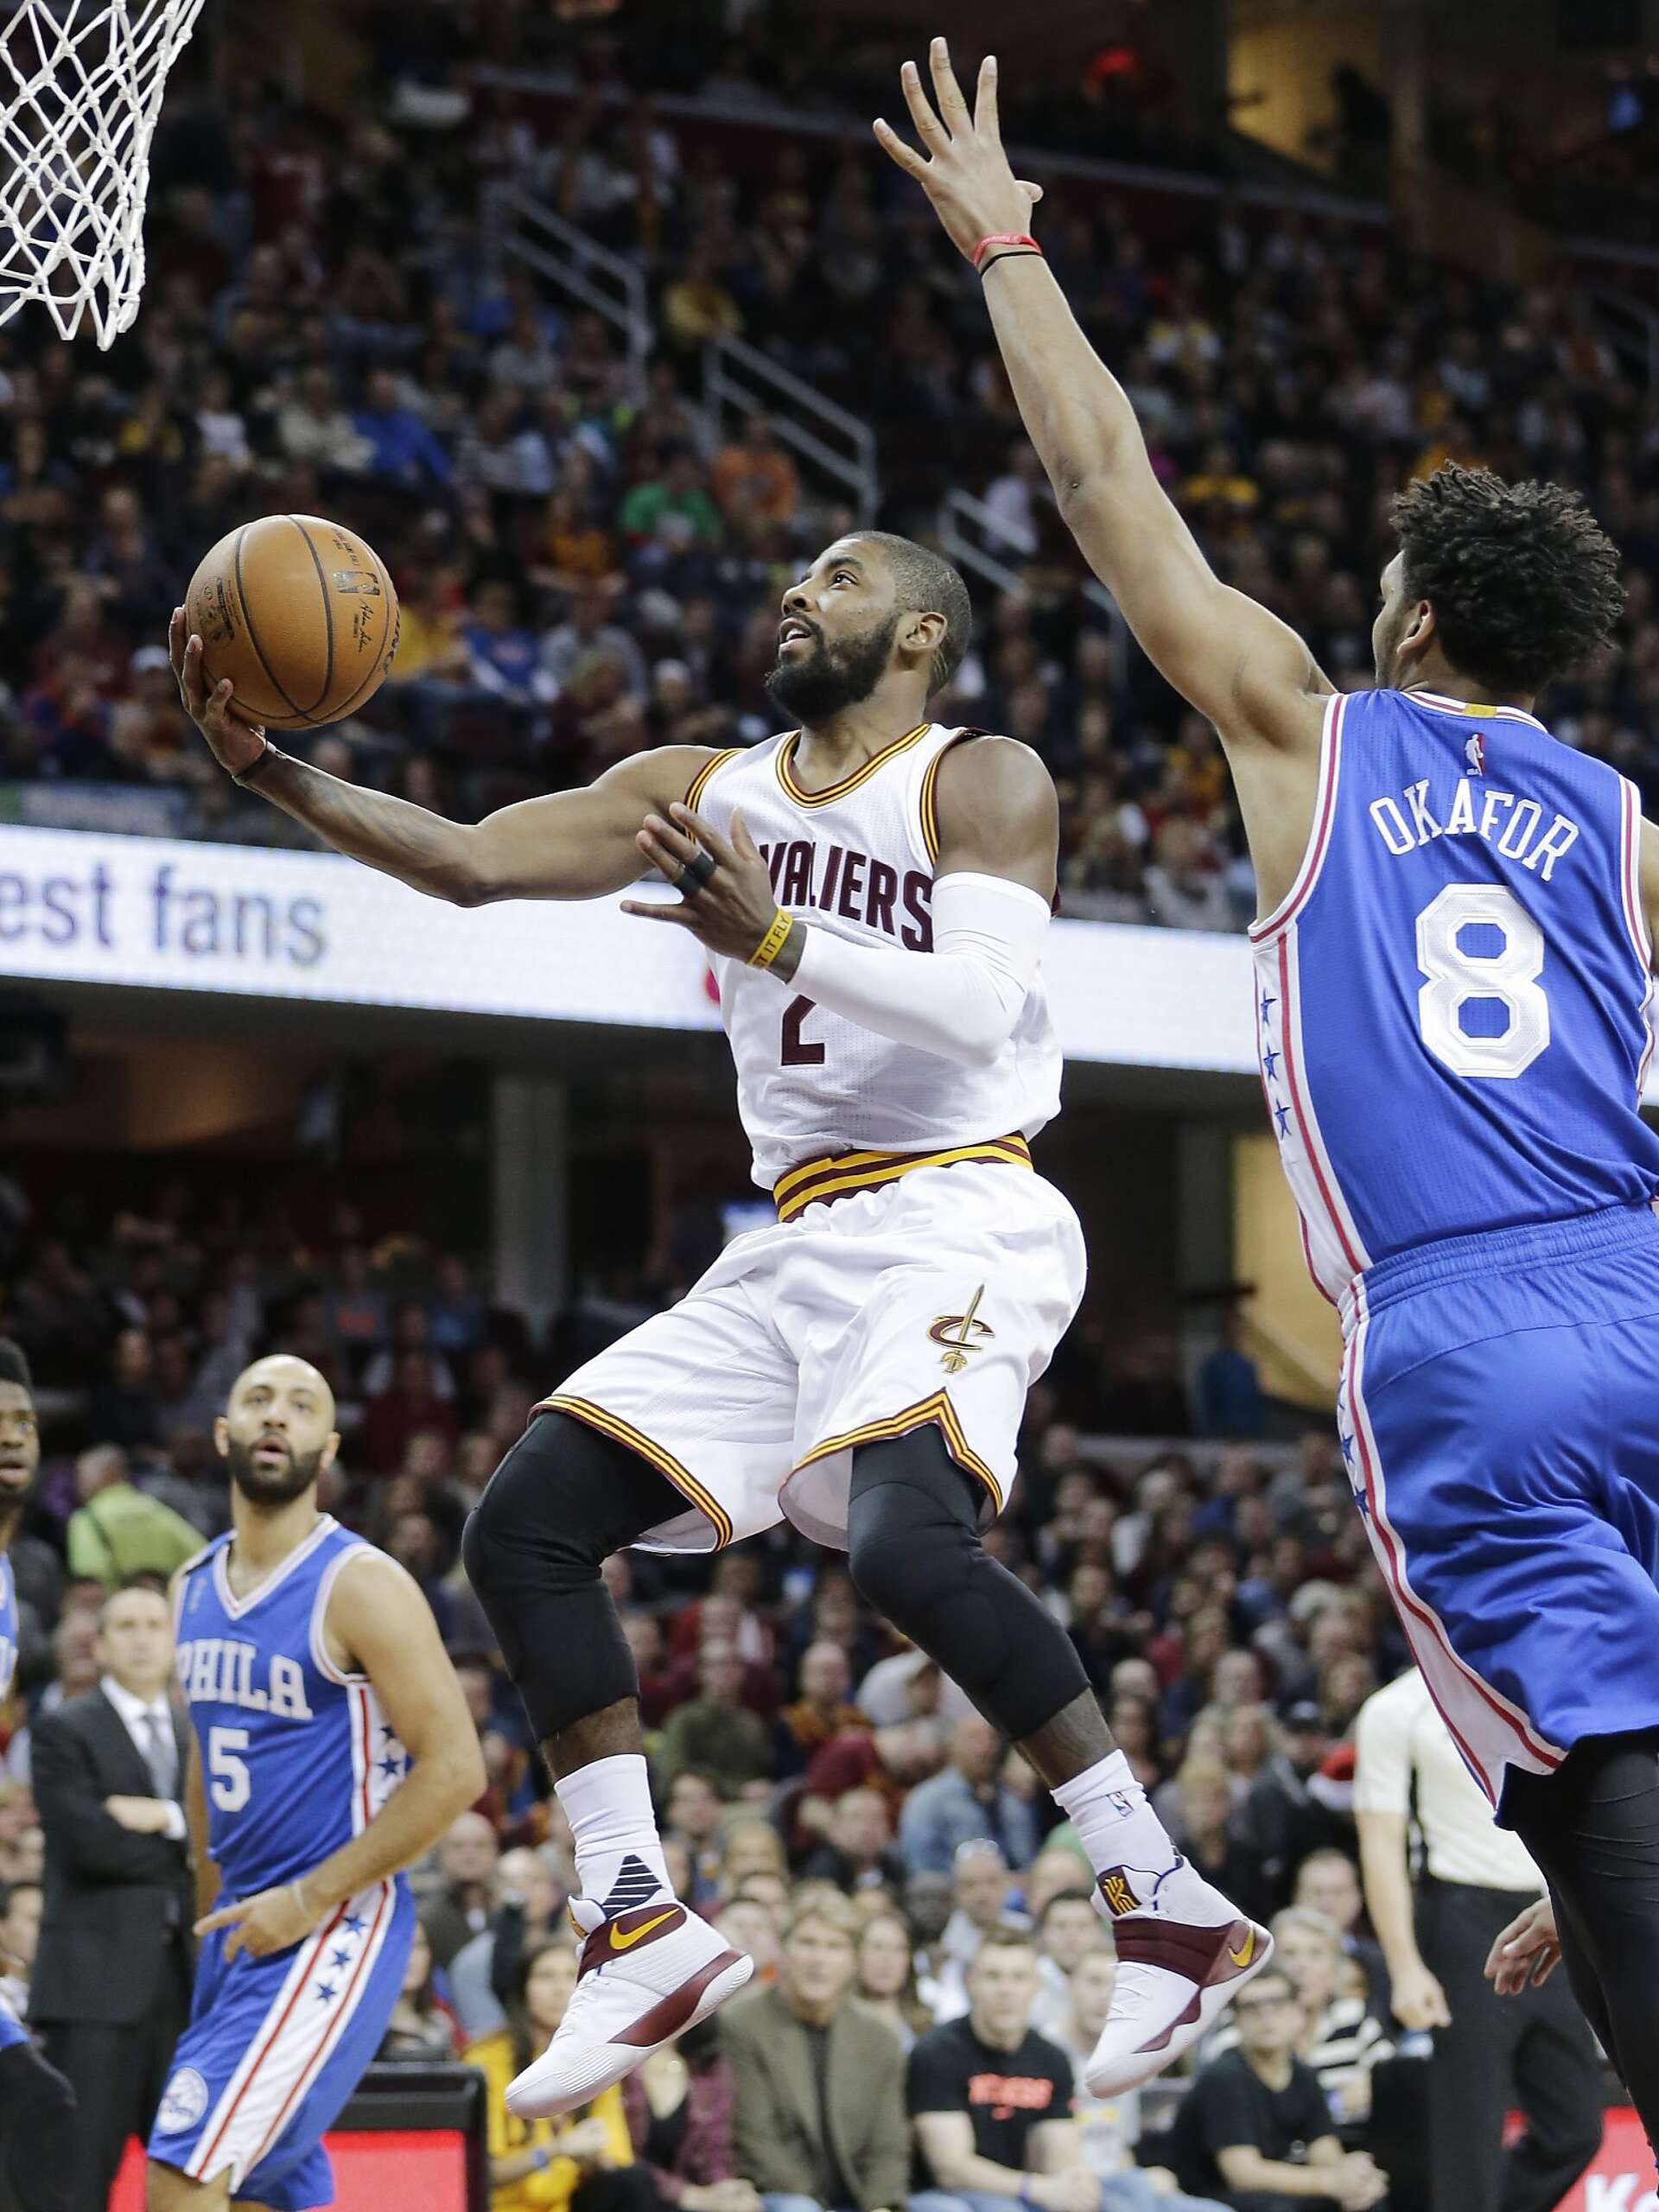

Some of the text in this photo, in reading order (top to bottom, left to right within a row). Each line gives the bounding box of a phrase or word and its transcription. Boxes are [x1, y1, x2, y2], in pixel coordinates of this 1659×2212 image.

[1369, 778, 1580, 881] OKAFOR
[153, 864, 327, 966] fans
[764, 938, 776, 954] IT
[773, 915, 789, 939] FLY
[1415, 882, 1551, 1079] 8
[780, 994, 825, 1066] 2
[175, 1637, 315, 1720] PHILA
[207, 1726, 251, 1813] 5
